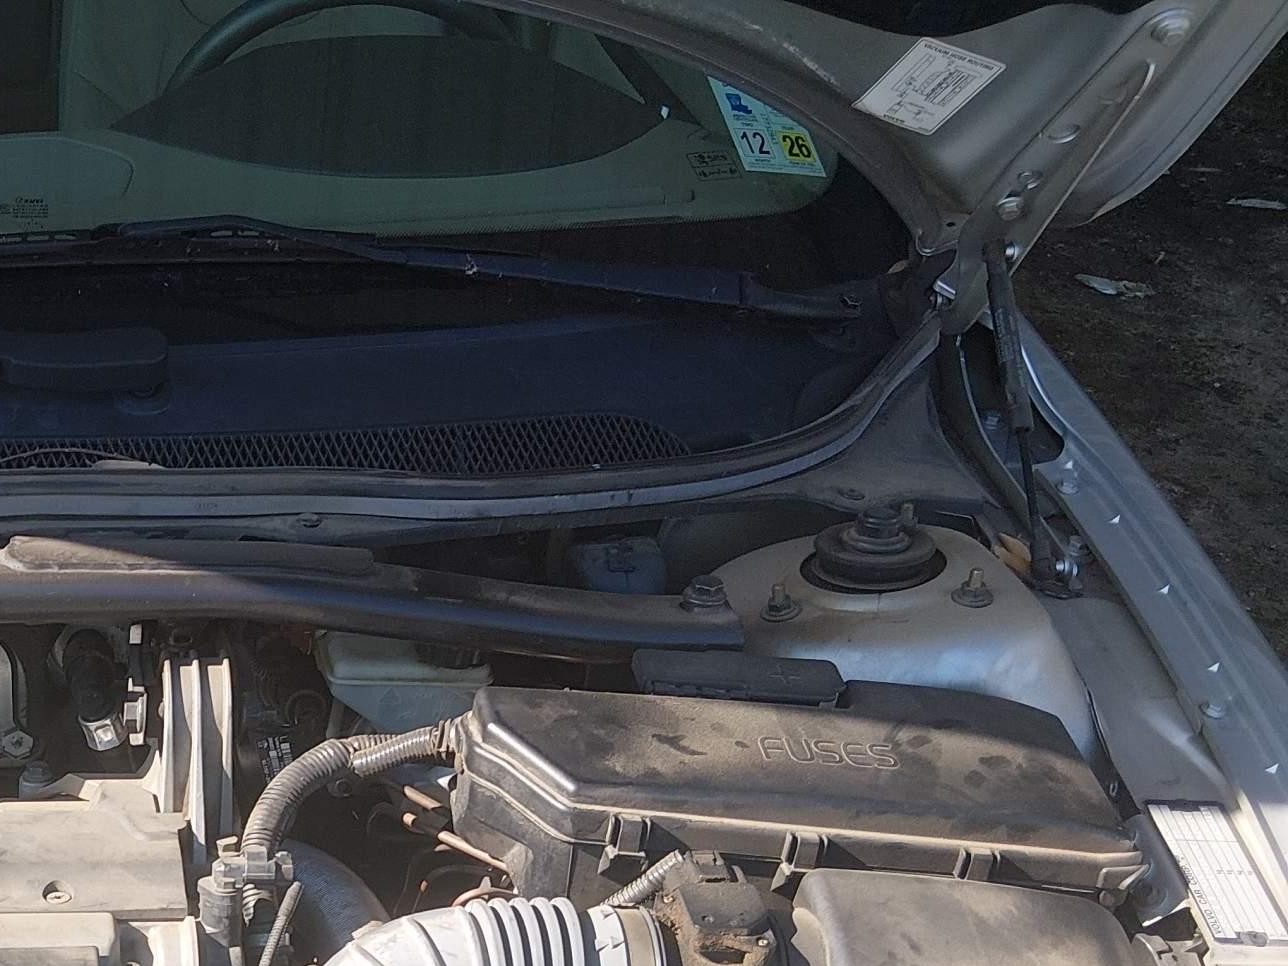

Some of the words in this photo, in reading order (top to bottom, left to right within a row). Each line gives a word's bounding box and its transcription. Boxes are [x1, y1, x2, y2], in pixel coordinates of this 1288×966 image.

[924, 43, 950, 55] VACUUM
[967, 59, 994, 71] ROUTING
[741, 131, 770, 155] 12
[782, 135, 811, 158] 26
[758, 735, 900, 770] FUSES
[1193, 889, 1209, 905] CAR
[1205, 908, 1223, 935] VOLVO
